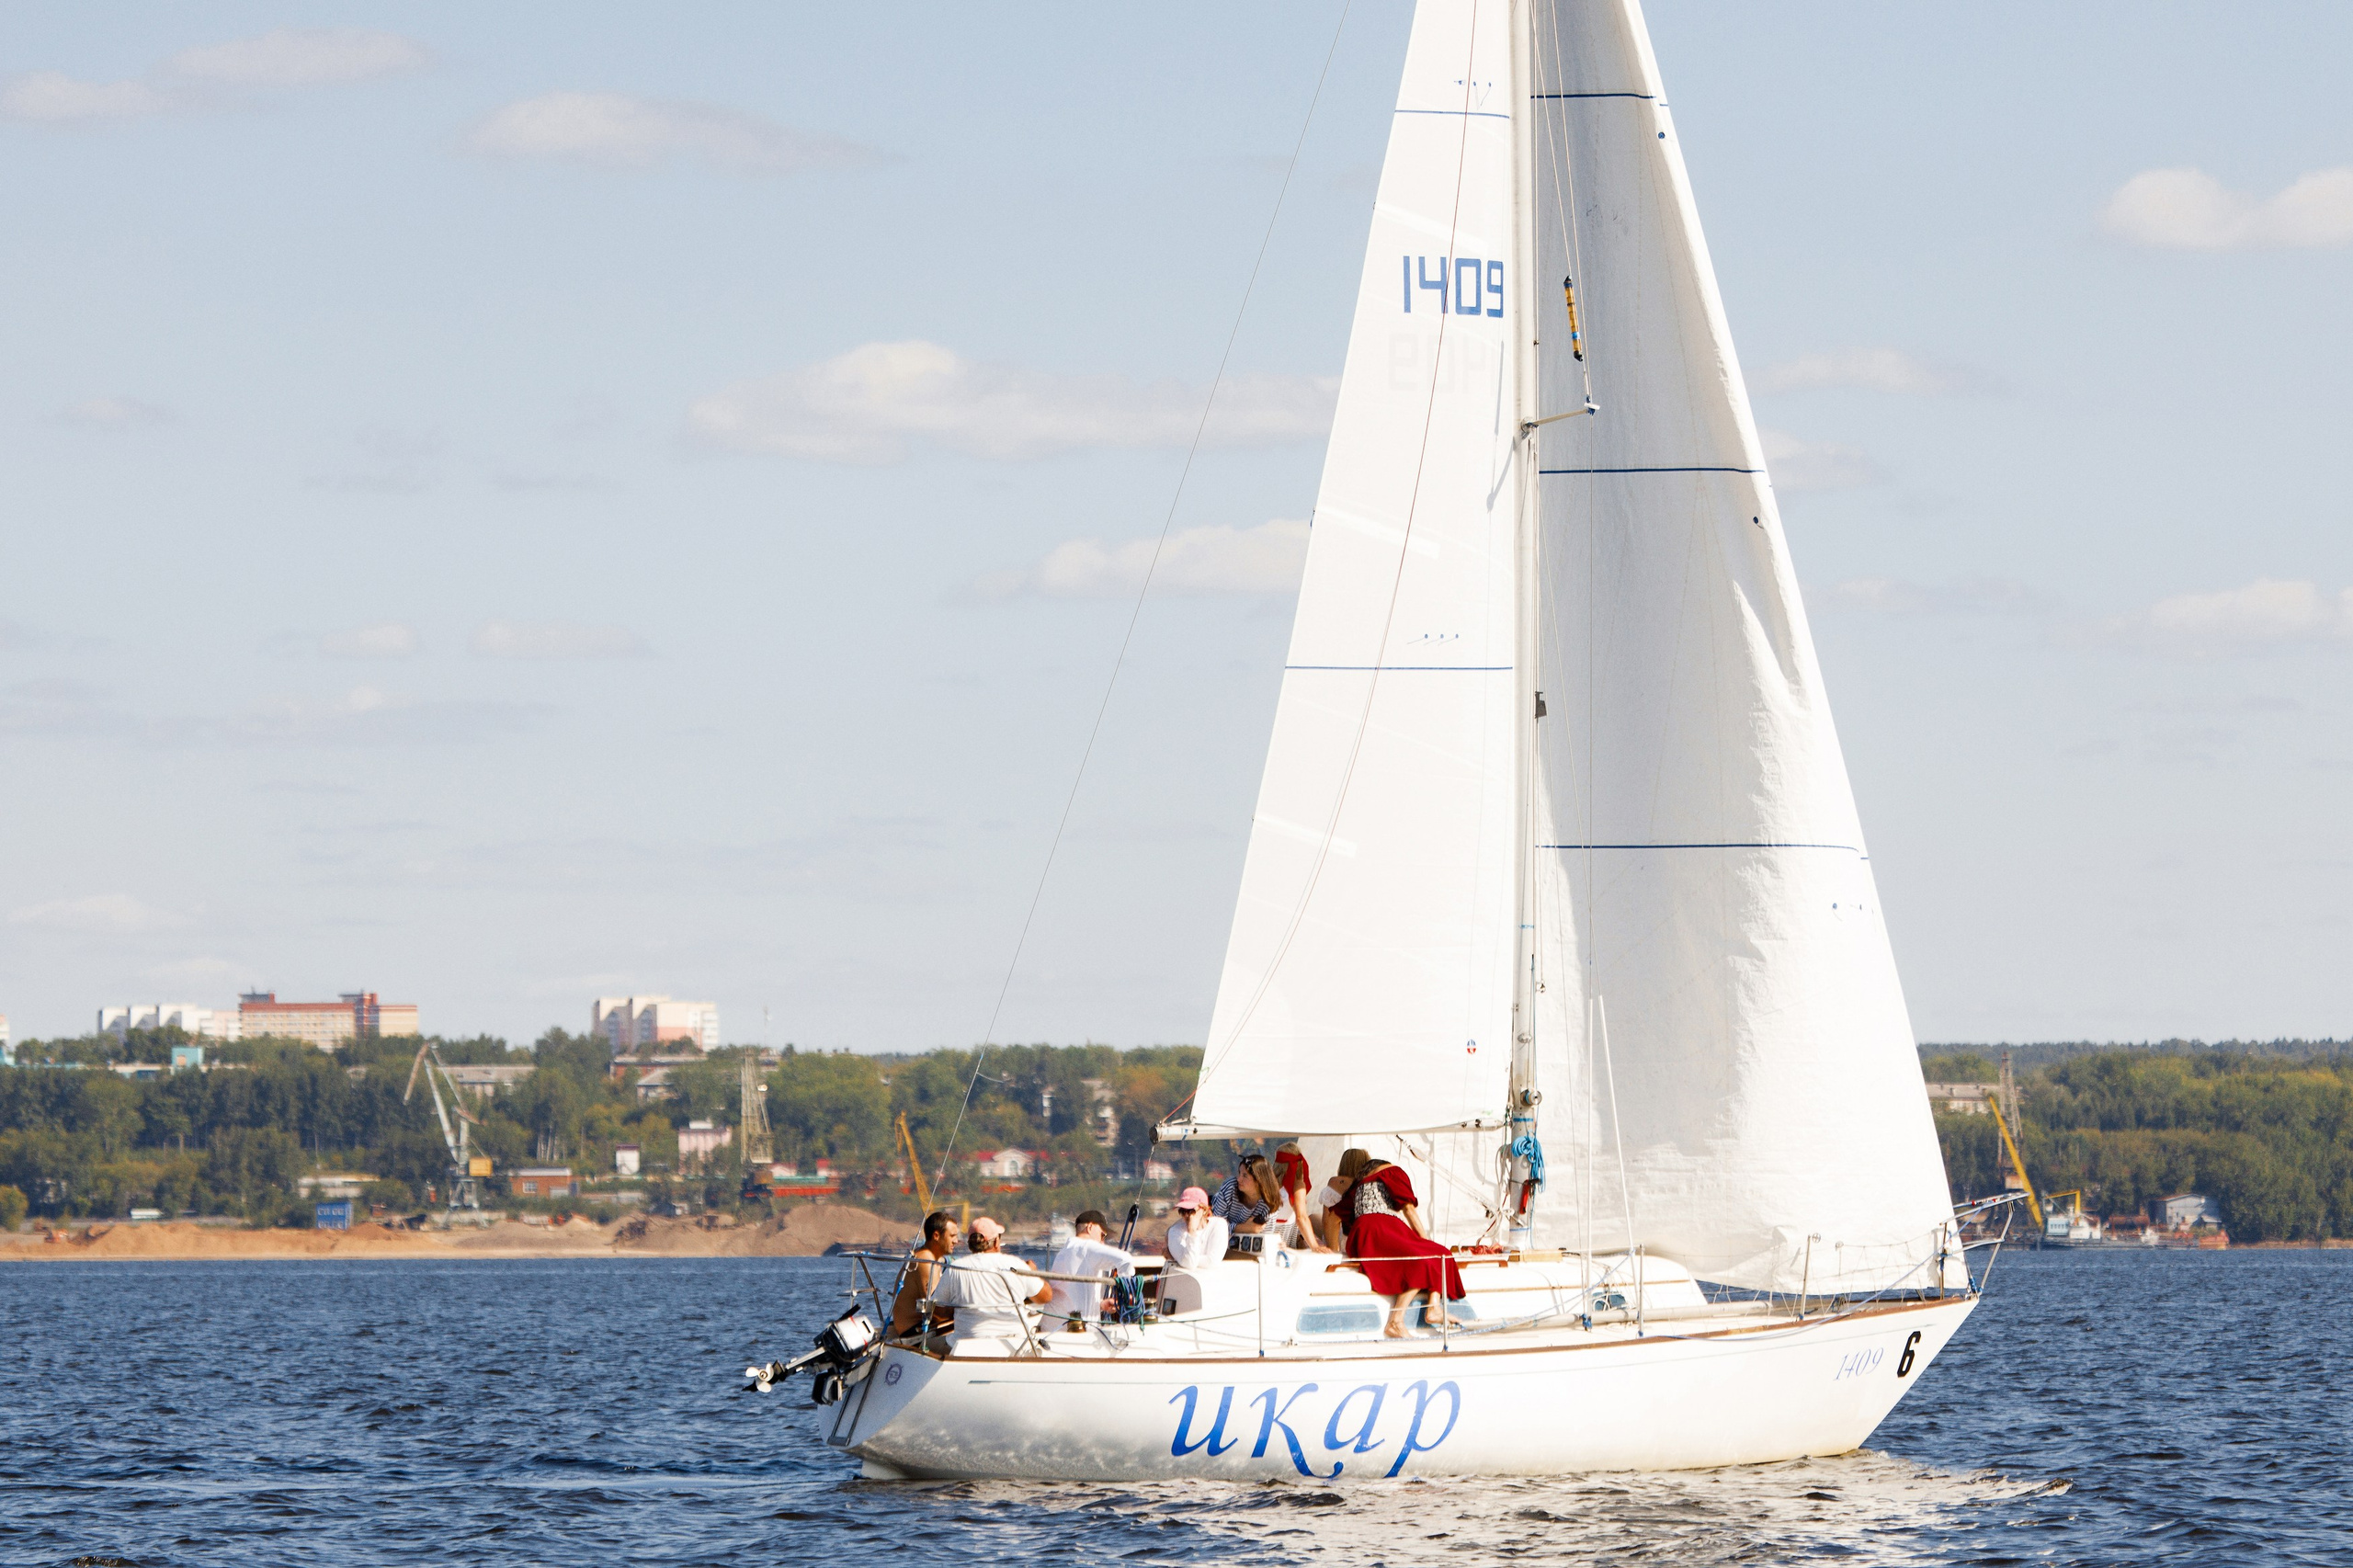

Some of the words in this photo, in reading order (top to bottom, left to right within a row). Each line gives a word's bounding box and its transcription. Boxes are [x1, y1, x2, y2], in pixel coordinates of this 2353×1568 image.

[1403, 256, 1504, 318] 1409
[1833, 1346, 1884, 1381] 1409
[1896, 1330, 1922, 1379] 6
[1168, 1379, 1461, 1479] икар
